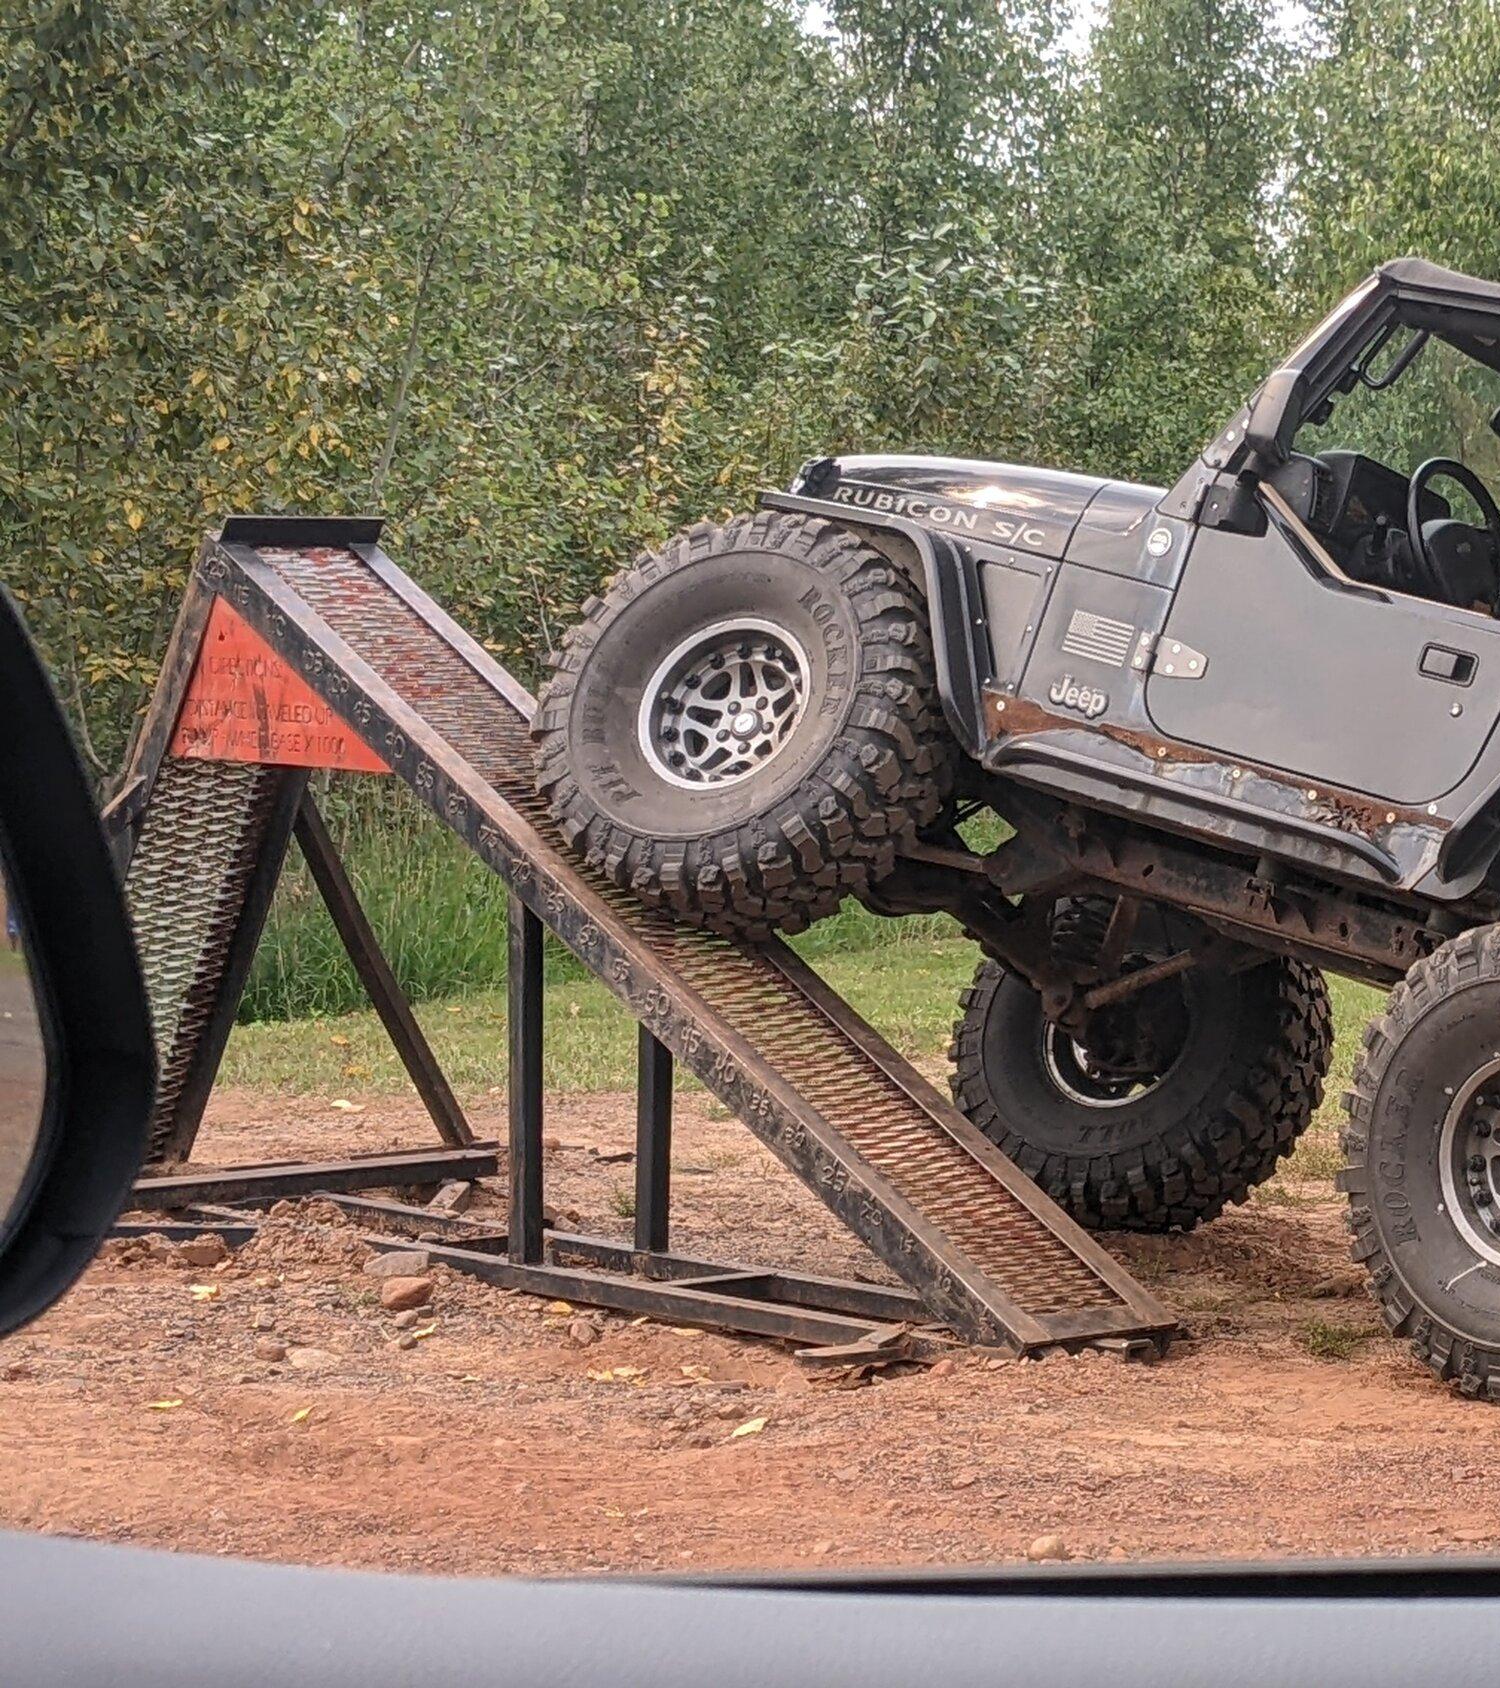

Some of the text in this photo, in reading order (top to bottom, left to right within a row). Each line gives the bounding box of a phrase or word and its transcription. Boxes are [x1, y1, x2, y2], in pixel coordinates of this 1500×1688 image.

[832, 486, 1046, 546] RUBICON S/C
[798, 585, 851, 716] ROCKER
[1050, 673, 1108, 718] Jeep
[315, 706, 332, 725] UP
[304, 736, 314, 752] X
[385, 731, 406, 759] 90
[416, 761, 435, 789] 85
[511, 859, 531, 881] 70
[681, 1026, 702, 1057] 45
[821, 1164, 848, 1193] 25
